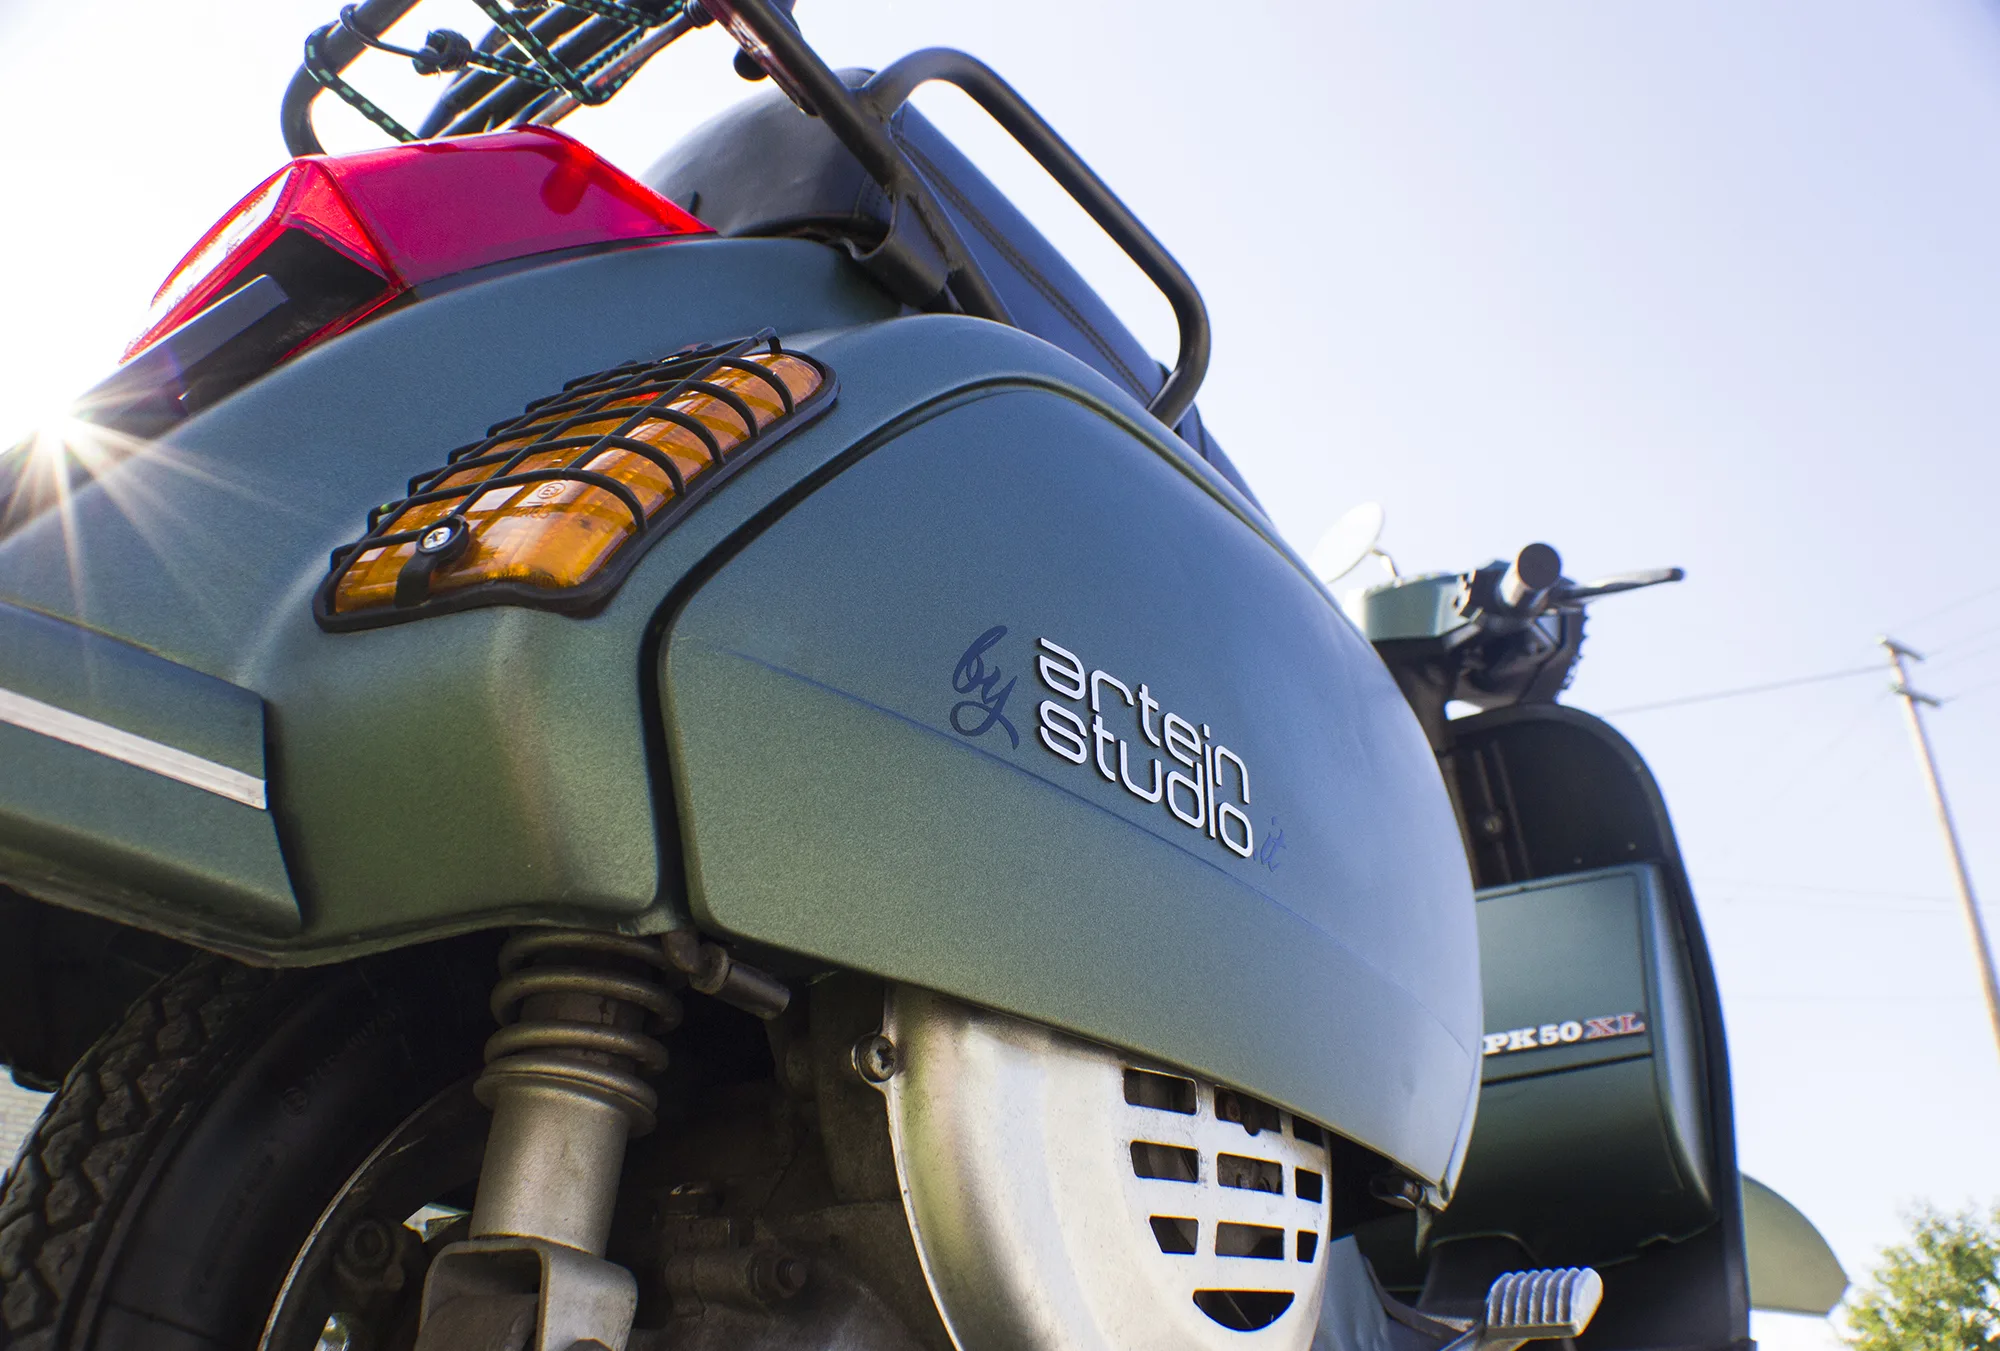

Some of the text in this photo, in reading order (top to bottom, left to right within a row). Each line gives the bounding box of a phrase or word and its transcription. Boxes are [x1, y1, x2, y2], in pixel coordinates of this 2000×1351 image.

[951, 625, 1019, 750] by
[1038, 637, 1250, 804] artein
[1038, 700, 1253, 858] studio
[1585, 1013, 1646, 1039] XL
